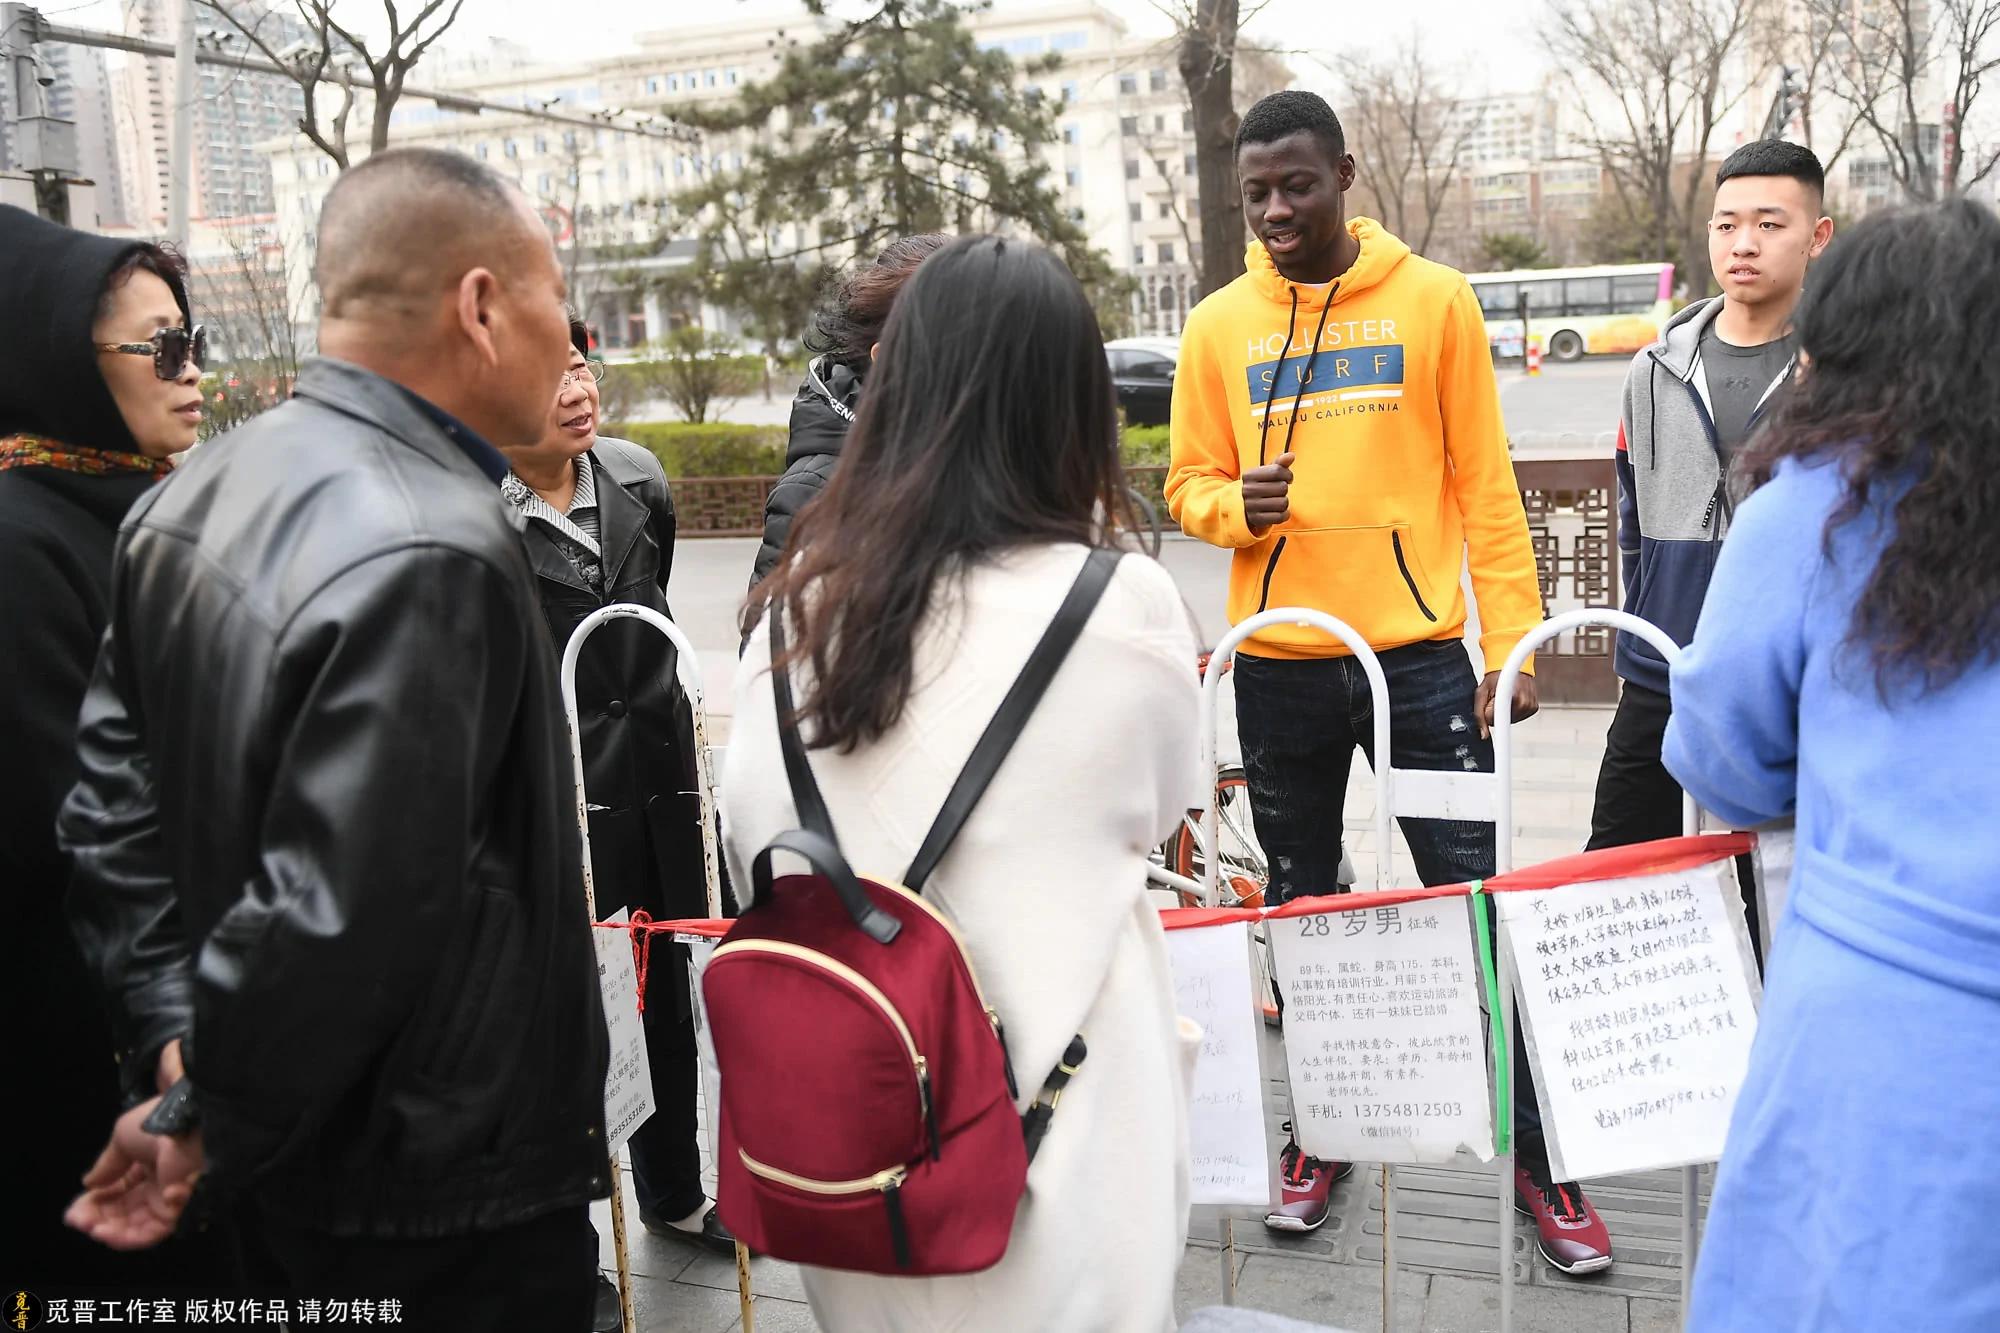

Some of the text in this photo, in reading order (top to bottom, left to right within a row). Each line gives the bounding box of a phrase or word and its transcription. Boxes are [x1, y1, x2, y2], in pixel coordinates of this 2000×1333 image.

[1247, 319, 1397, 361] HOLLISTER
[1261, 354, 1388, 391] SURF
[1258, 402, 1399, 430] MALIU CALIFORNIA
[1300, 906, 1439, 937] 28 岁男 征婚
[1354, 1102, 1462, 1118] 13754812503
